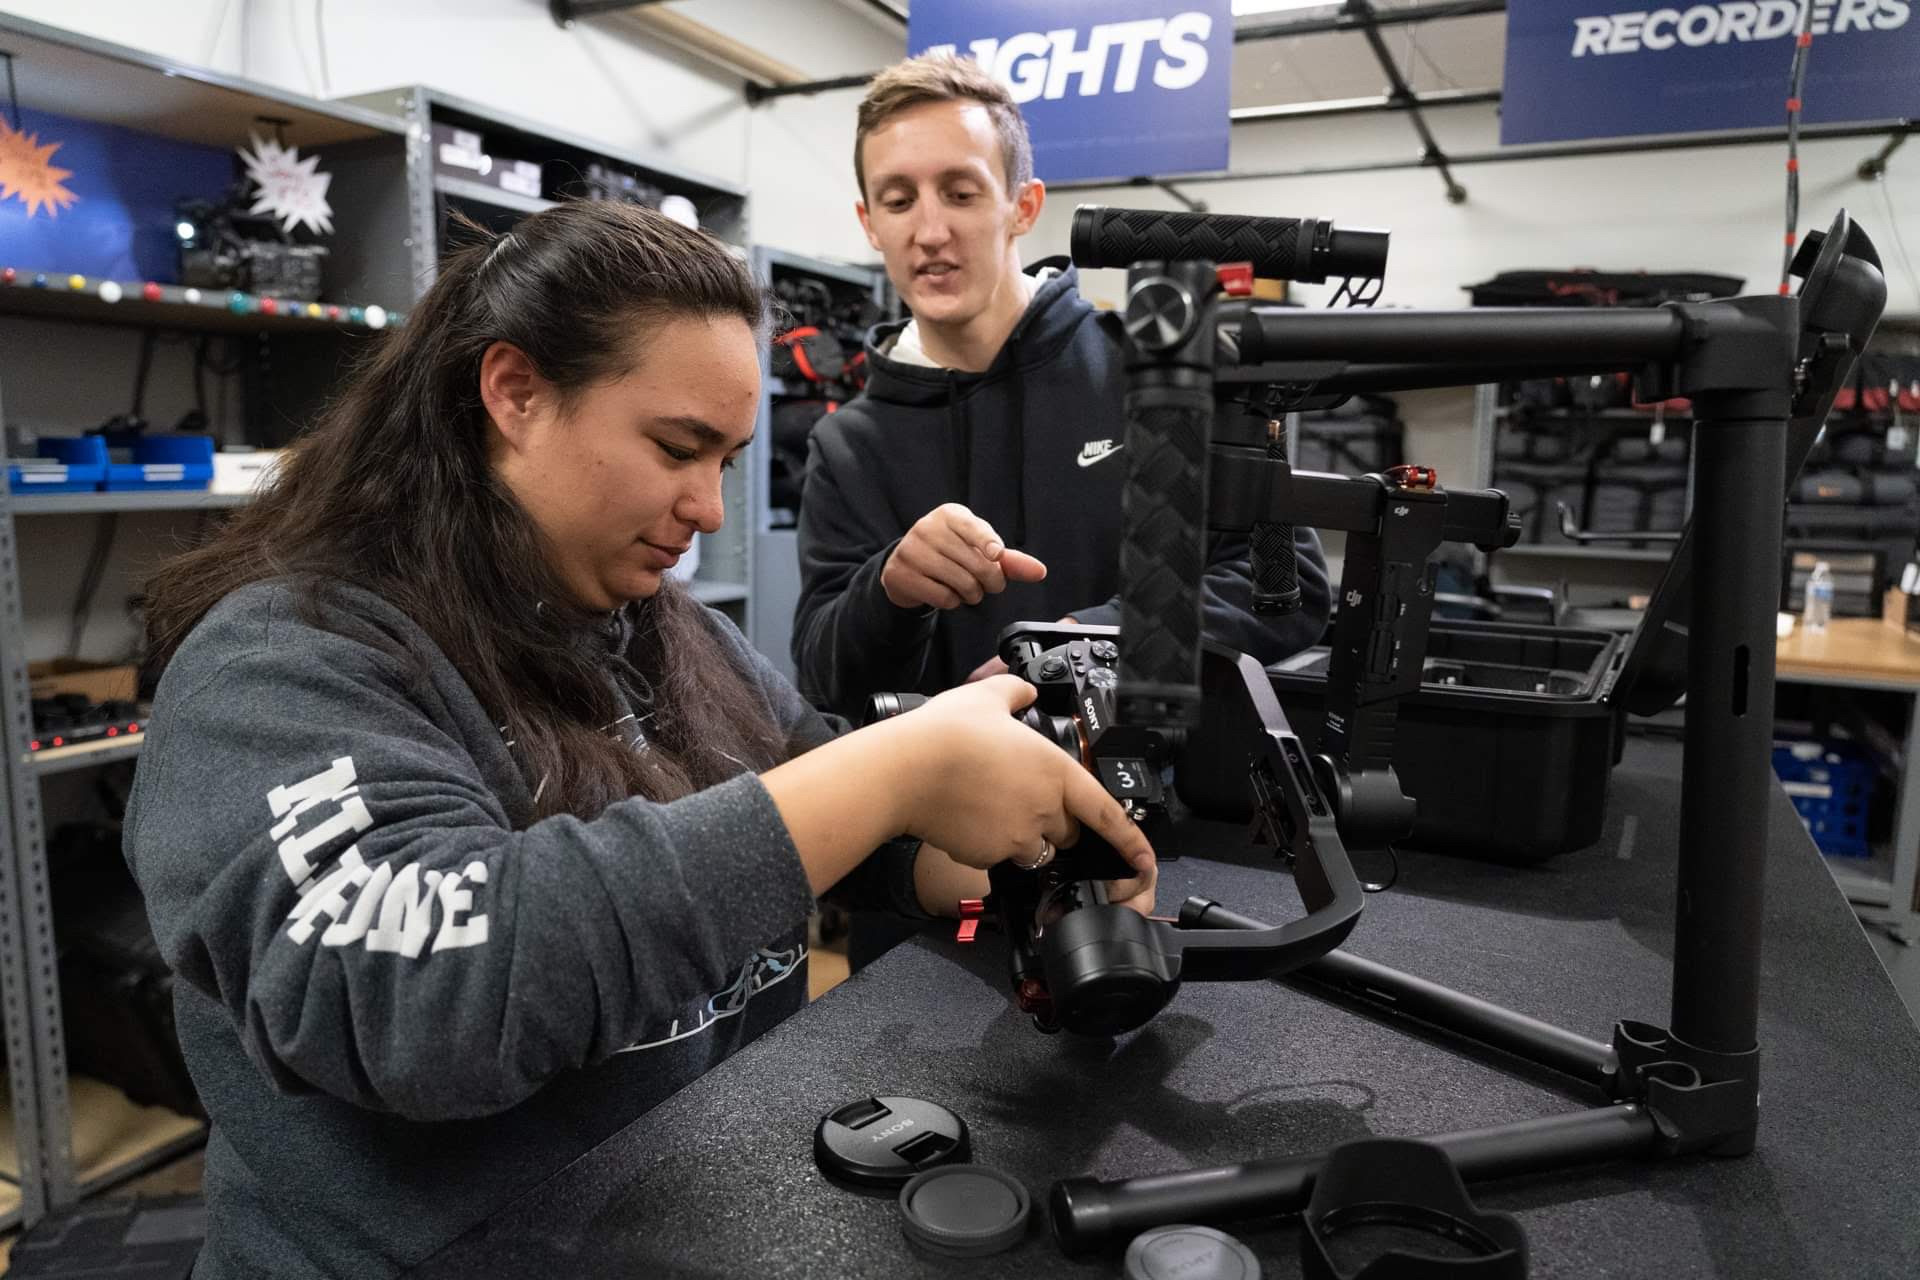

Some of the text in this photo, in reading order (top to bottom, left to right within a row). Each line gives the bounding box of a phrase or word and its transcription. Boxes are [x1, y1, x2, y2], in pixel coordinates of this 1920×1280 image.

[1571, 0, 1912, 57] RECORDERS
[928, 11, 1213, 105] IGHTS
[1084, 439, 1113, 457] NIKE
[1083, 697, 1100, 731] SONY
[872, 1118, 915, 1143] SONY
